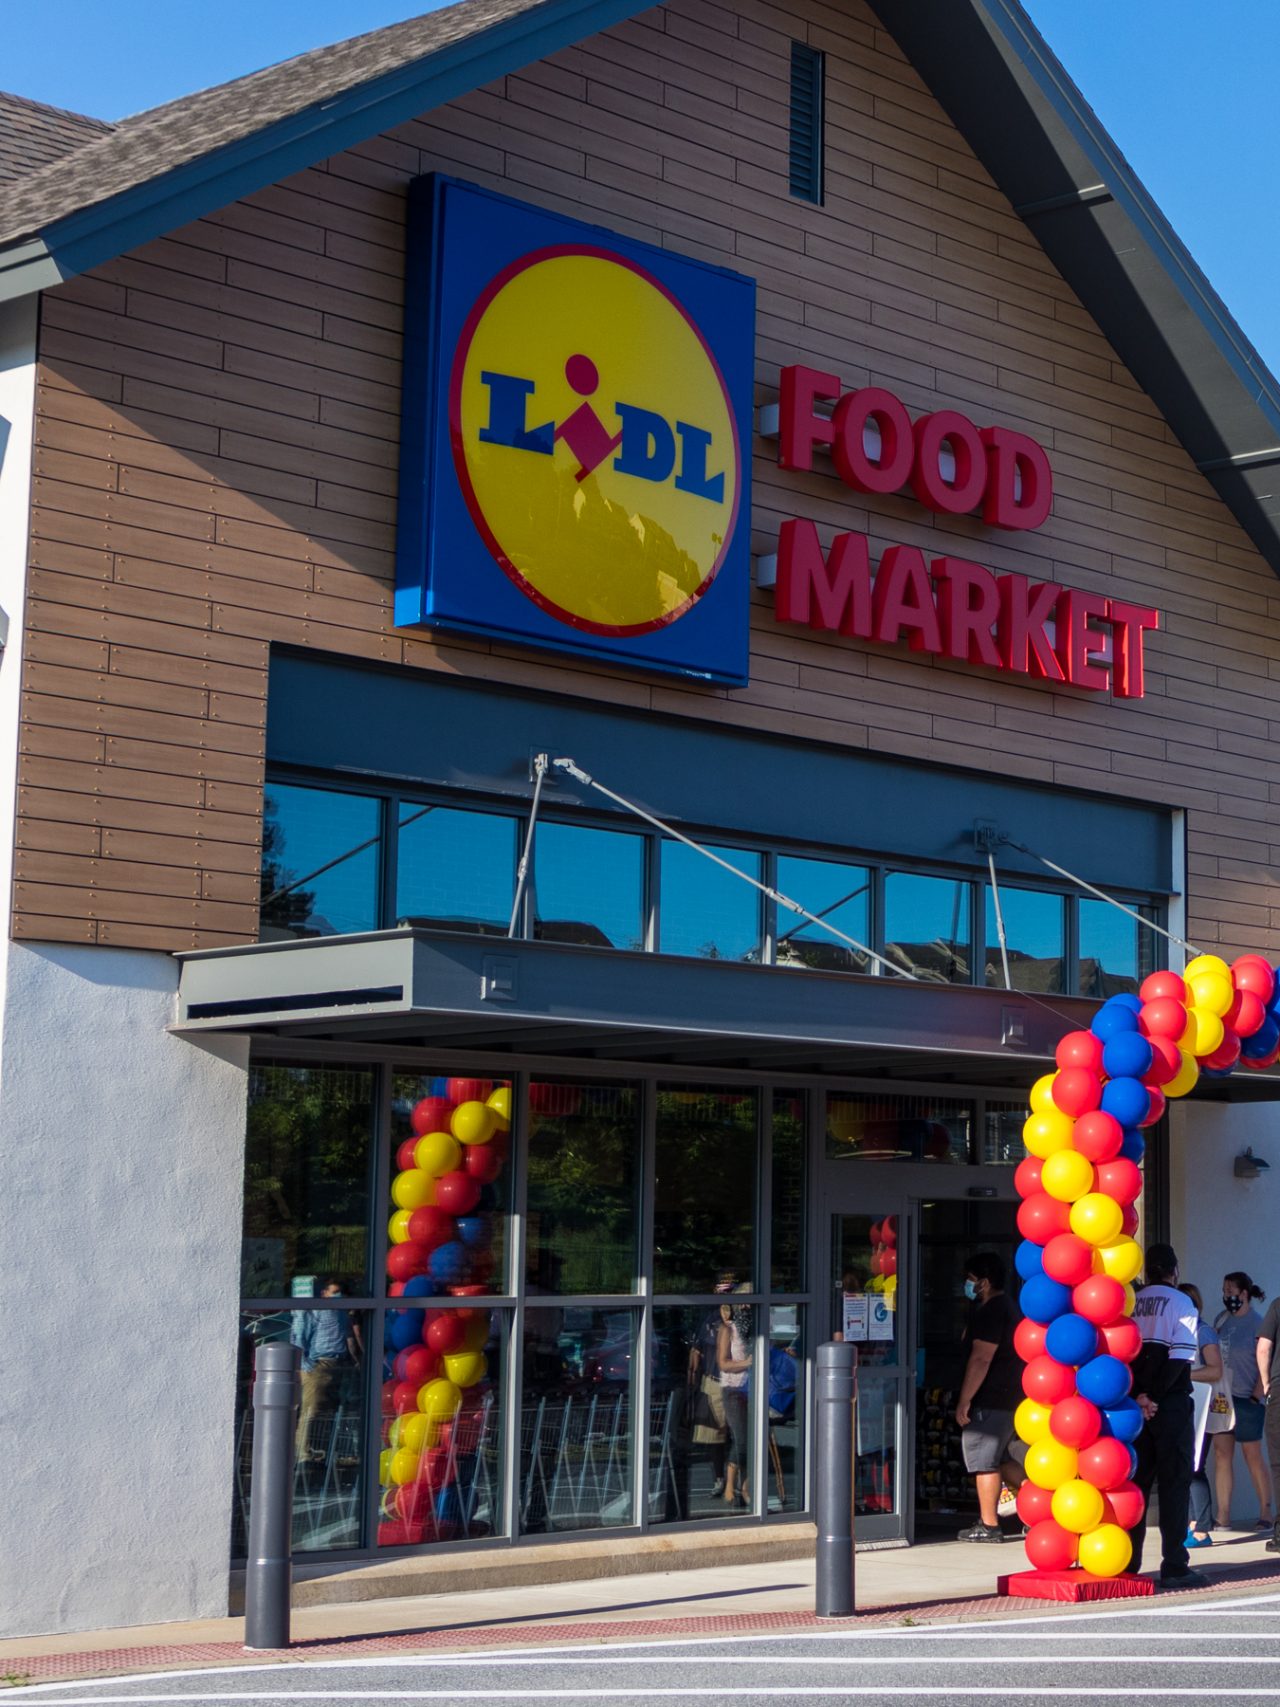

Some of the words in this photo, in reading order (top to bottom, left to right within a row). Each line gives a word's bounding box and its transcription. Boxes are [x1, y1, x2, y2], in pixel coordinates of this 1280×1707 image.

[778, 364, 1053, 531] FOOD
[775, 519, 1159, 699] MARKET
[1132, 1296, 1170, 1317] CURITY
